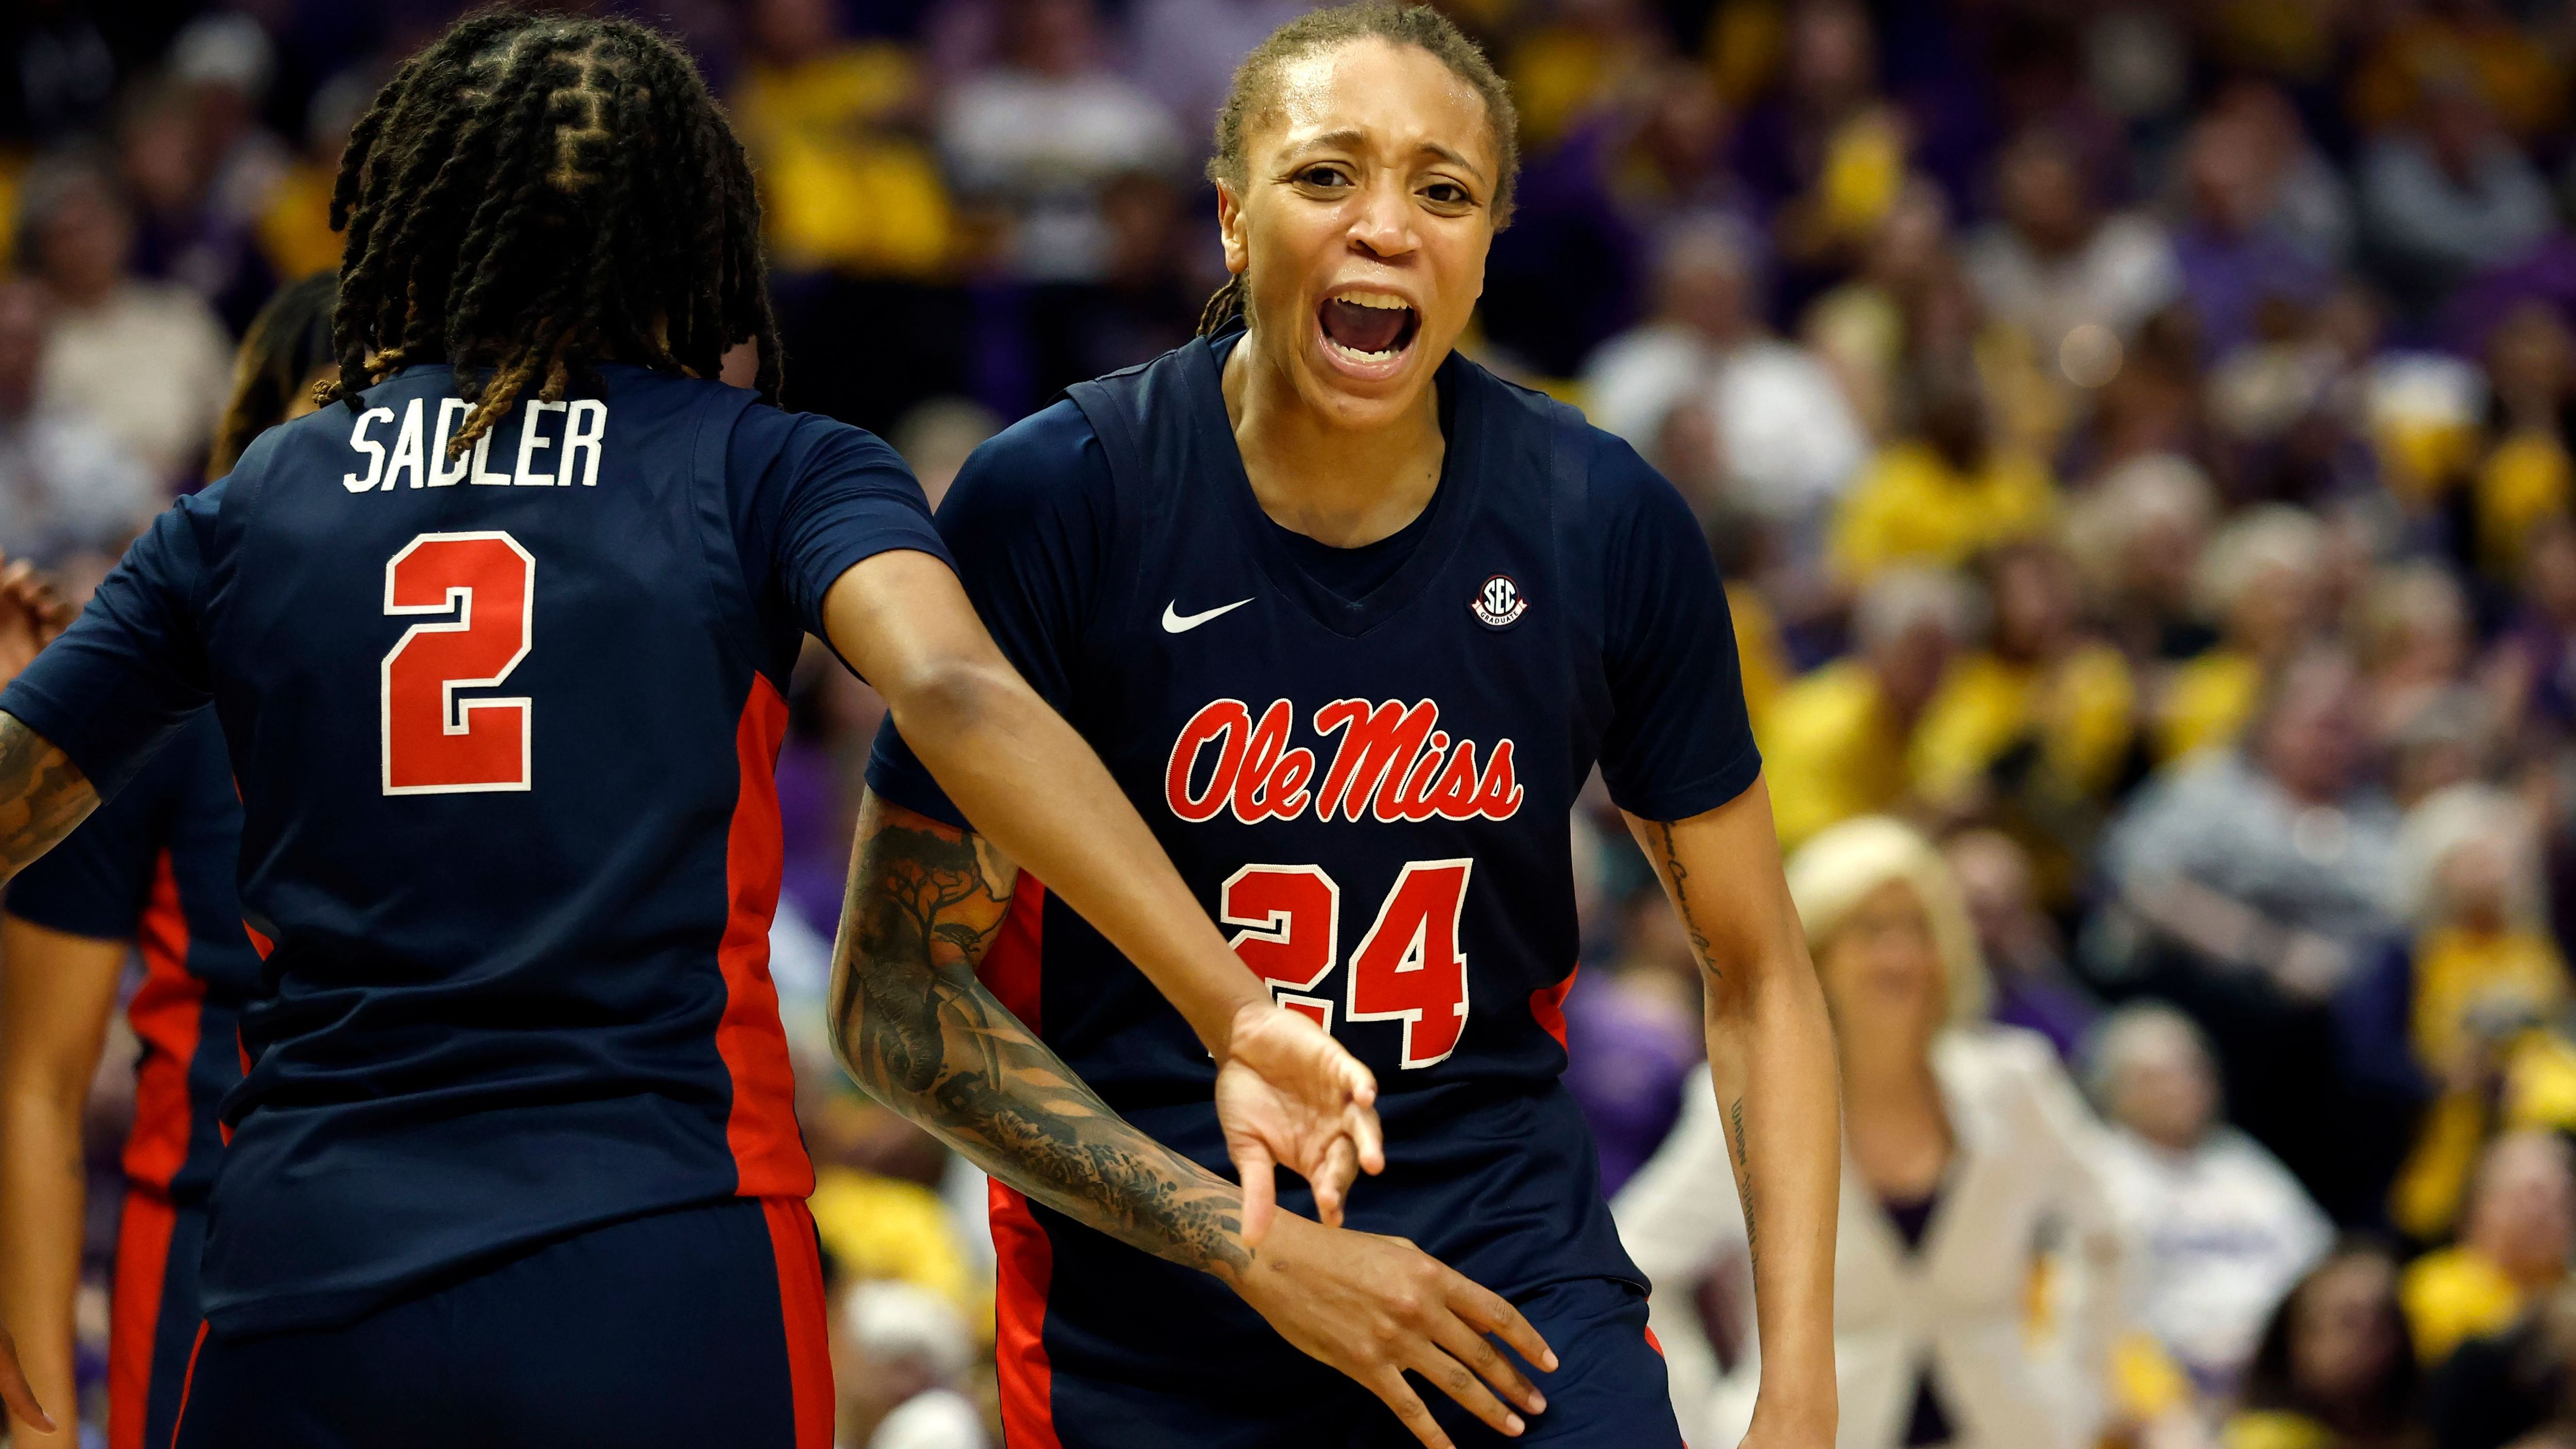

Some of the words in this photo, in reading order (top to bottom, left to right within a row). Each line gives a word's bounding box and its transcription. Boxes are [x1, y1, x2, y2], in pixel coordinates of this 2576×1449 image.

[343, 398, 607, 493] SADLER
[1481, 610, 1519, 624] GRADUATE
[1484, 578, 1516, 614] SEC
[381, 531, 536, 796] 2
[1165, 698, 1315, 825] Ole
[1314, 698, 1524, 823] Miss
[1208, 858, 1473, 1070] 24
